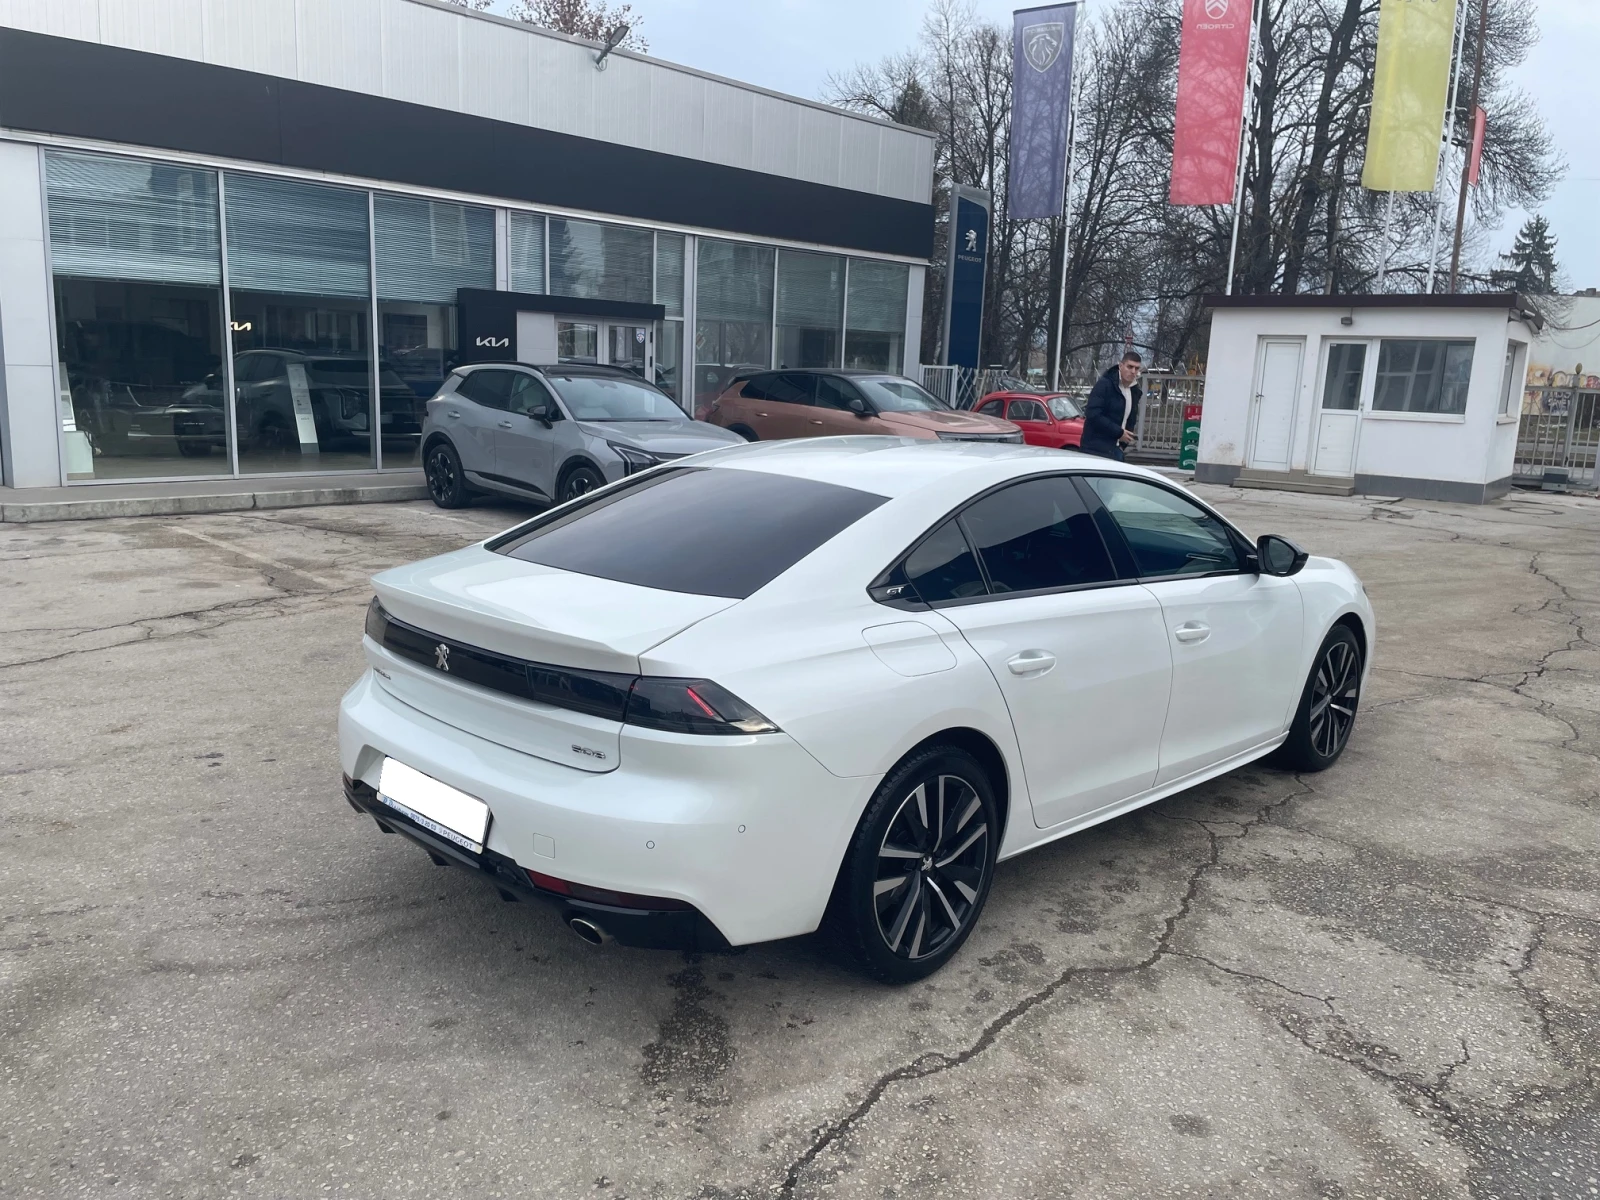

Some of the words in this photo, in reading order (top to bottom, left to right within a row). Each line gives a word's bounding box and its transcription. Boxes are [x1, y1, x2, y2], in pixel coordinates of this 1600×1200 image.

[957, 254, 982, 263] PEUGEOT
[476, 336, 509, 347] KIA
[571, 744, 606, 759] 508
[442, 829, 474, 849] PEUGEOT
